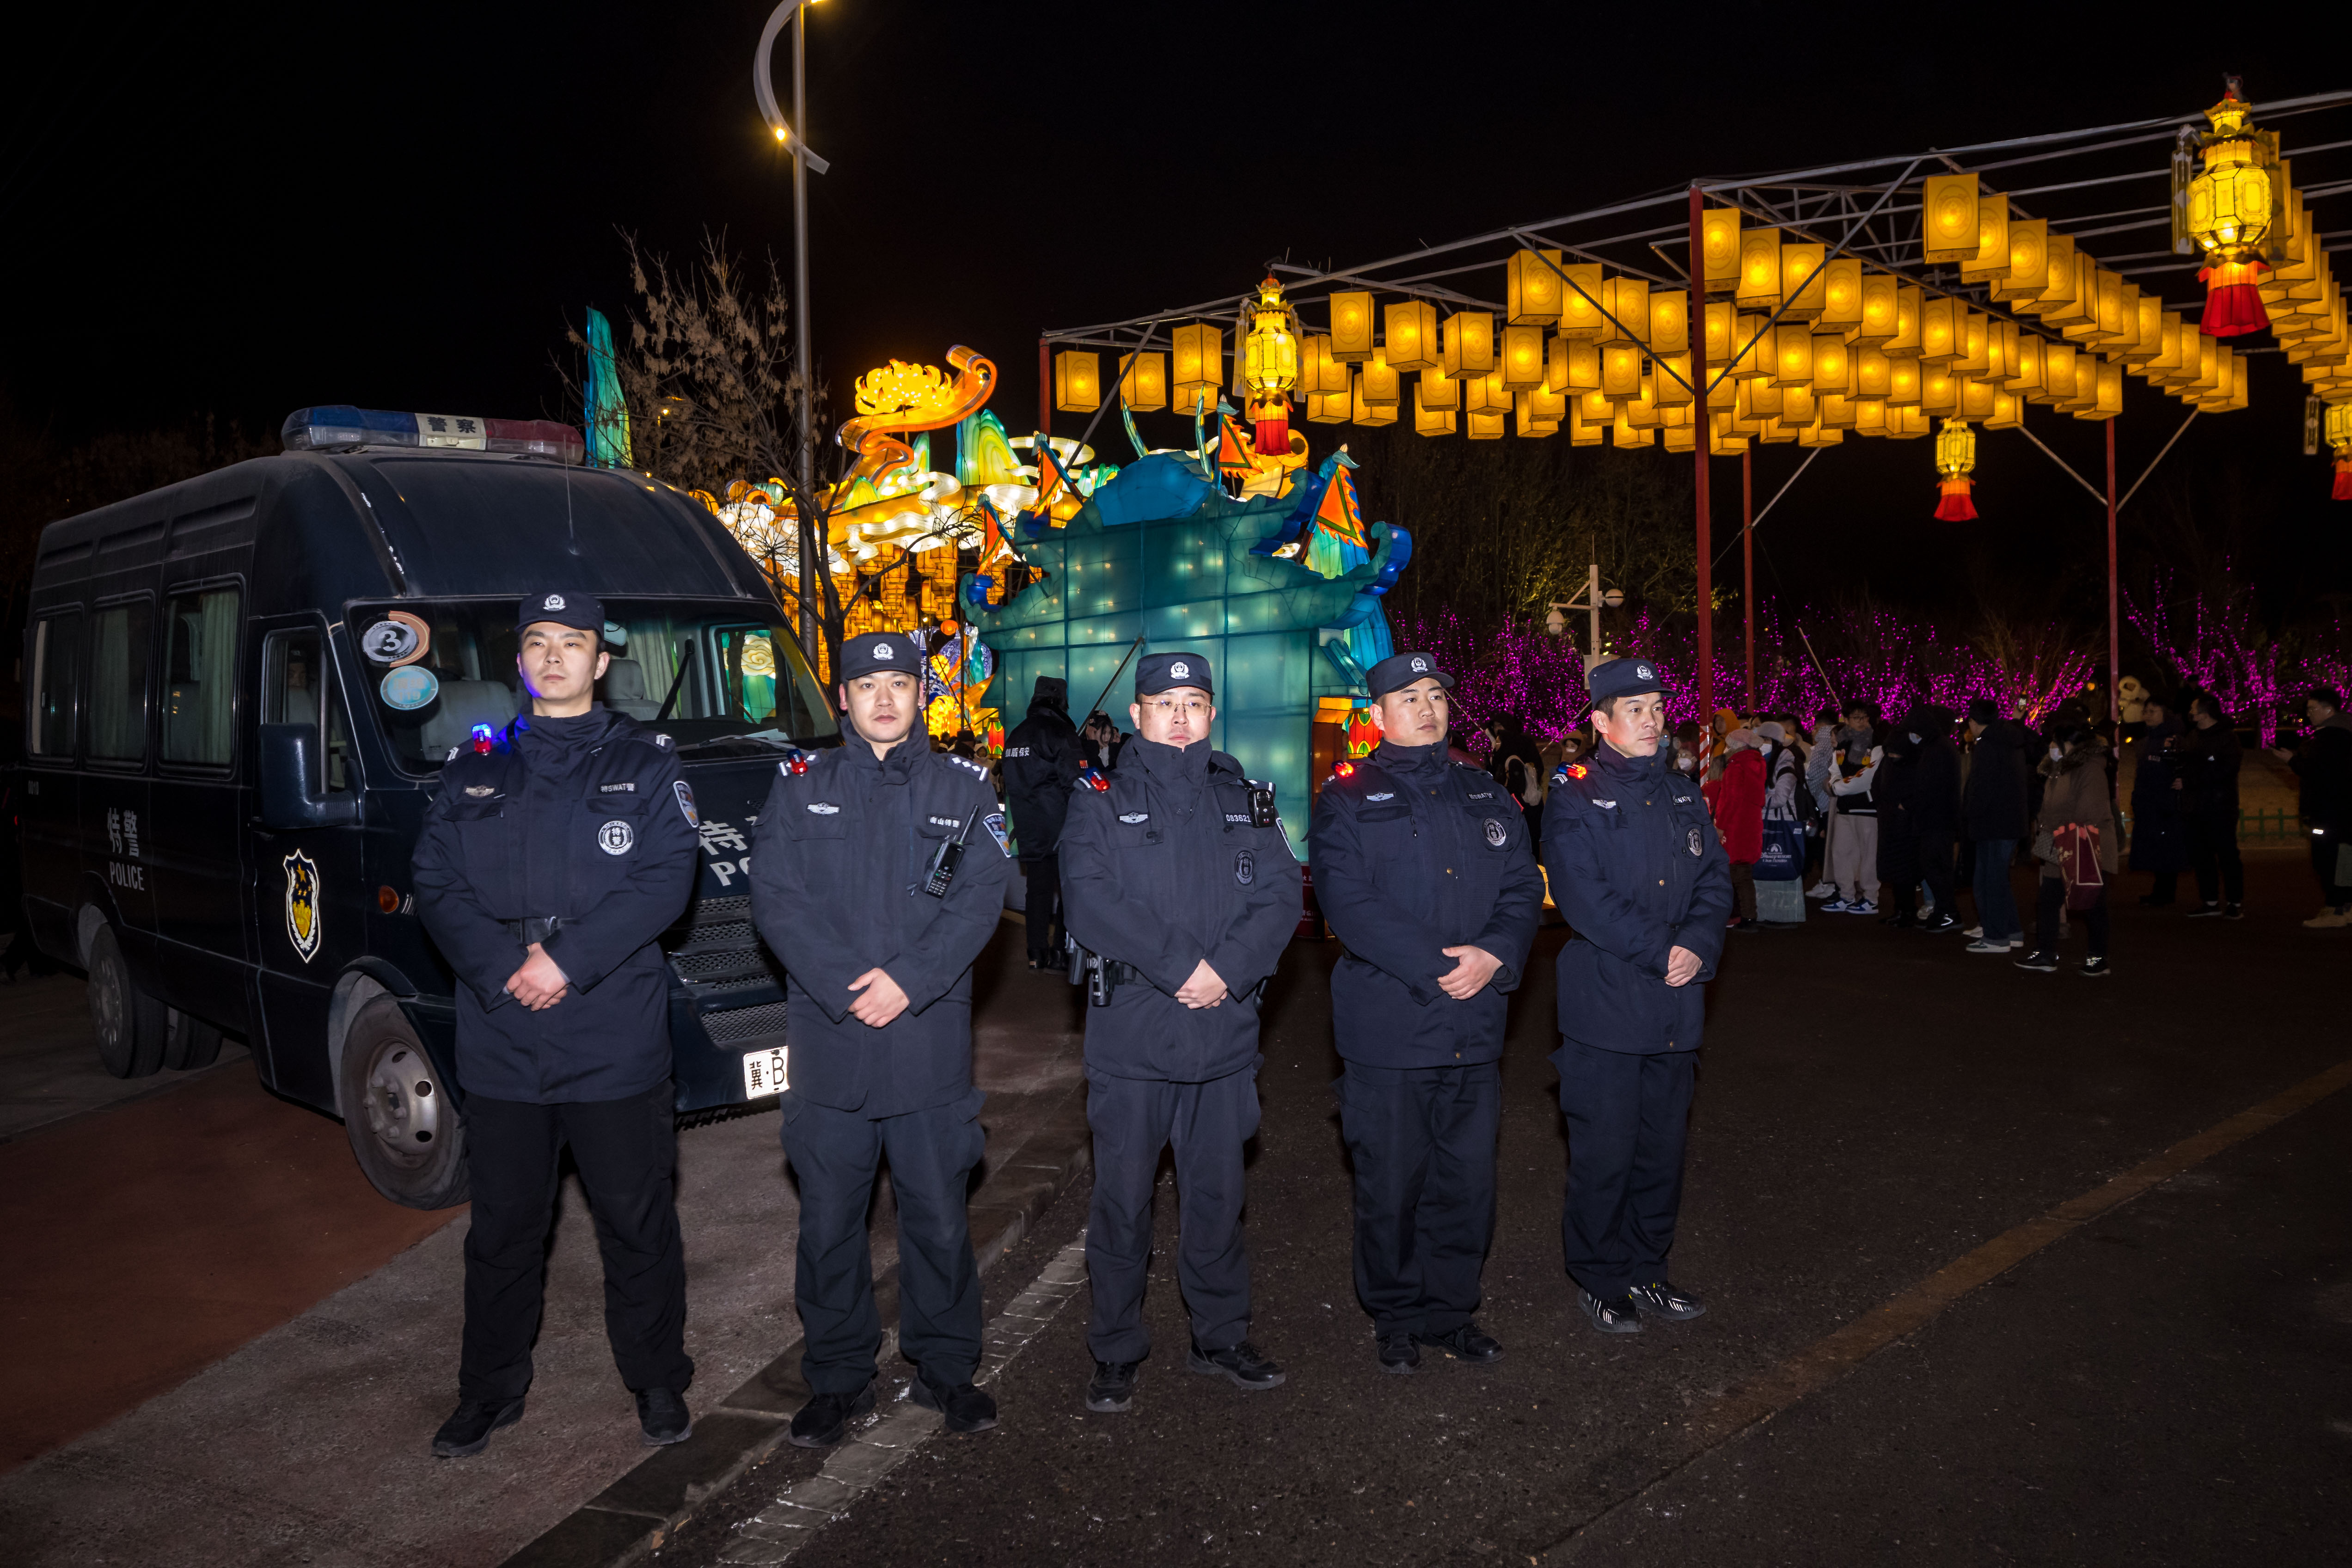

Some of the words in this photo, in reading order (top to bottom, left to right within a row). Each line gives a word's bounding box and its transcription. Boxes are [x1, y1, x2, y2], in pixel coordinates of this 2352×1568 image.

[427, 416, 476, 433] 警察
[378, 630, 402, 651] 3
[107, 808, 139, 857] 特警
[109, 861, 145, 891] POLICE
